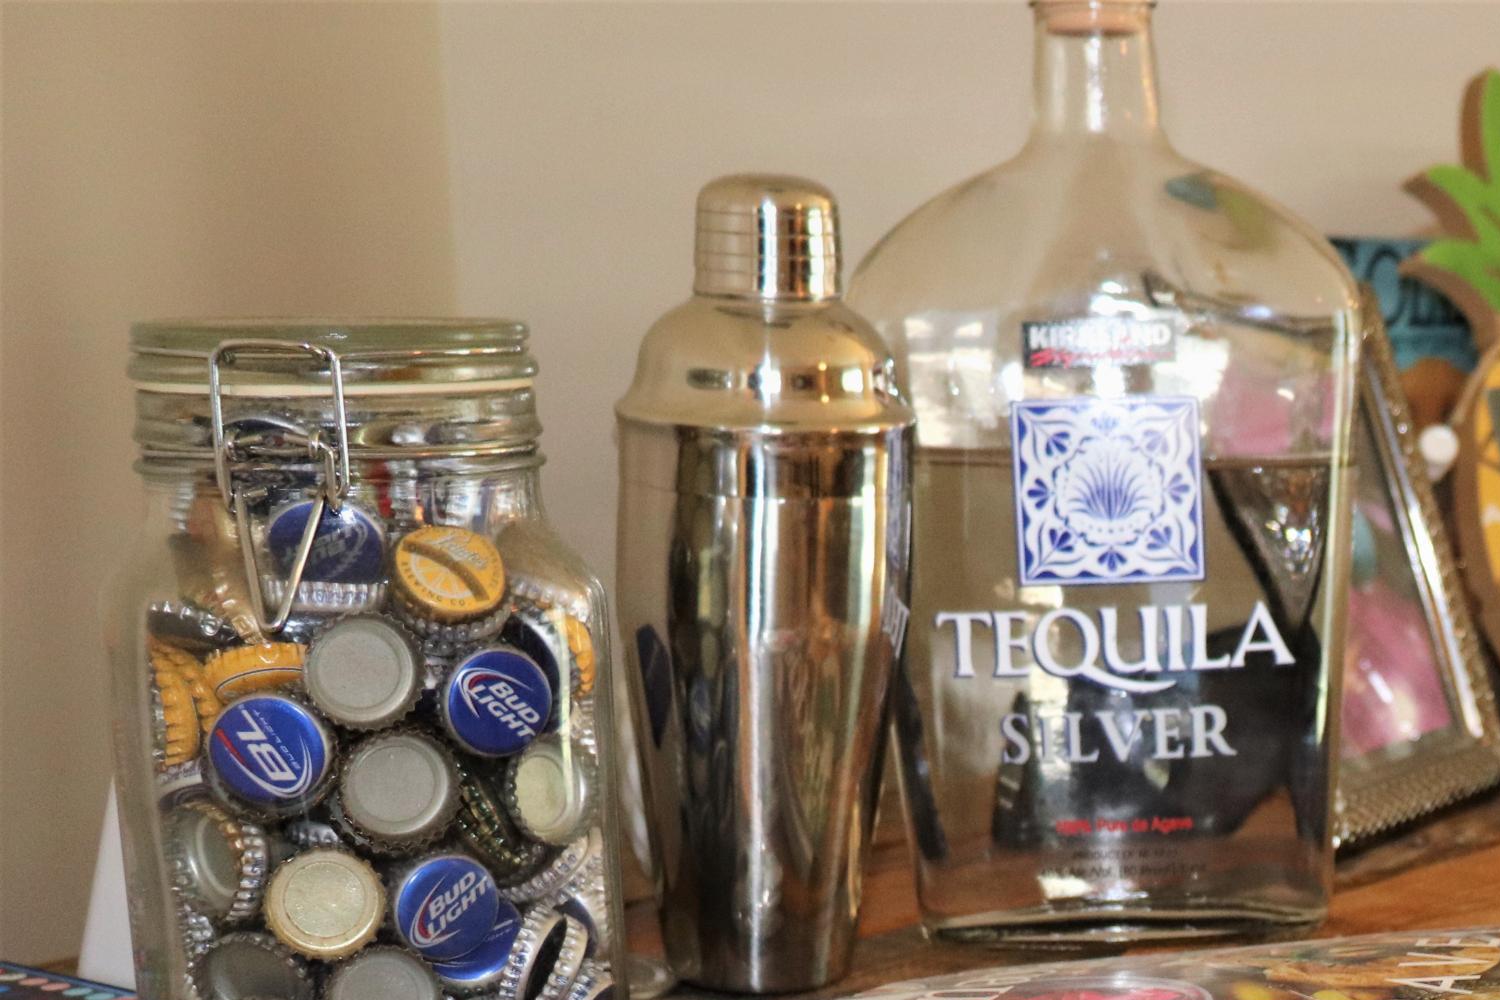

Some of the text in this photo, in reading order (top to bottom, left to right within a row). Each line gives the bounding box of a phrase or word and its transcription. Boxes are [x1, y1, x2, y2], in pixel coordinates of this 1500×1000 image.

[935, 600, 1296, 694] TEQUILA
[470, 684, 536, 737] LIGHT
[488, 681, 541, 724] BUD
[1001, 703, 1238, 766] SILVER
[427, 875, 488, 938] LIGHT
[428, 871, 476, 920] BUD
